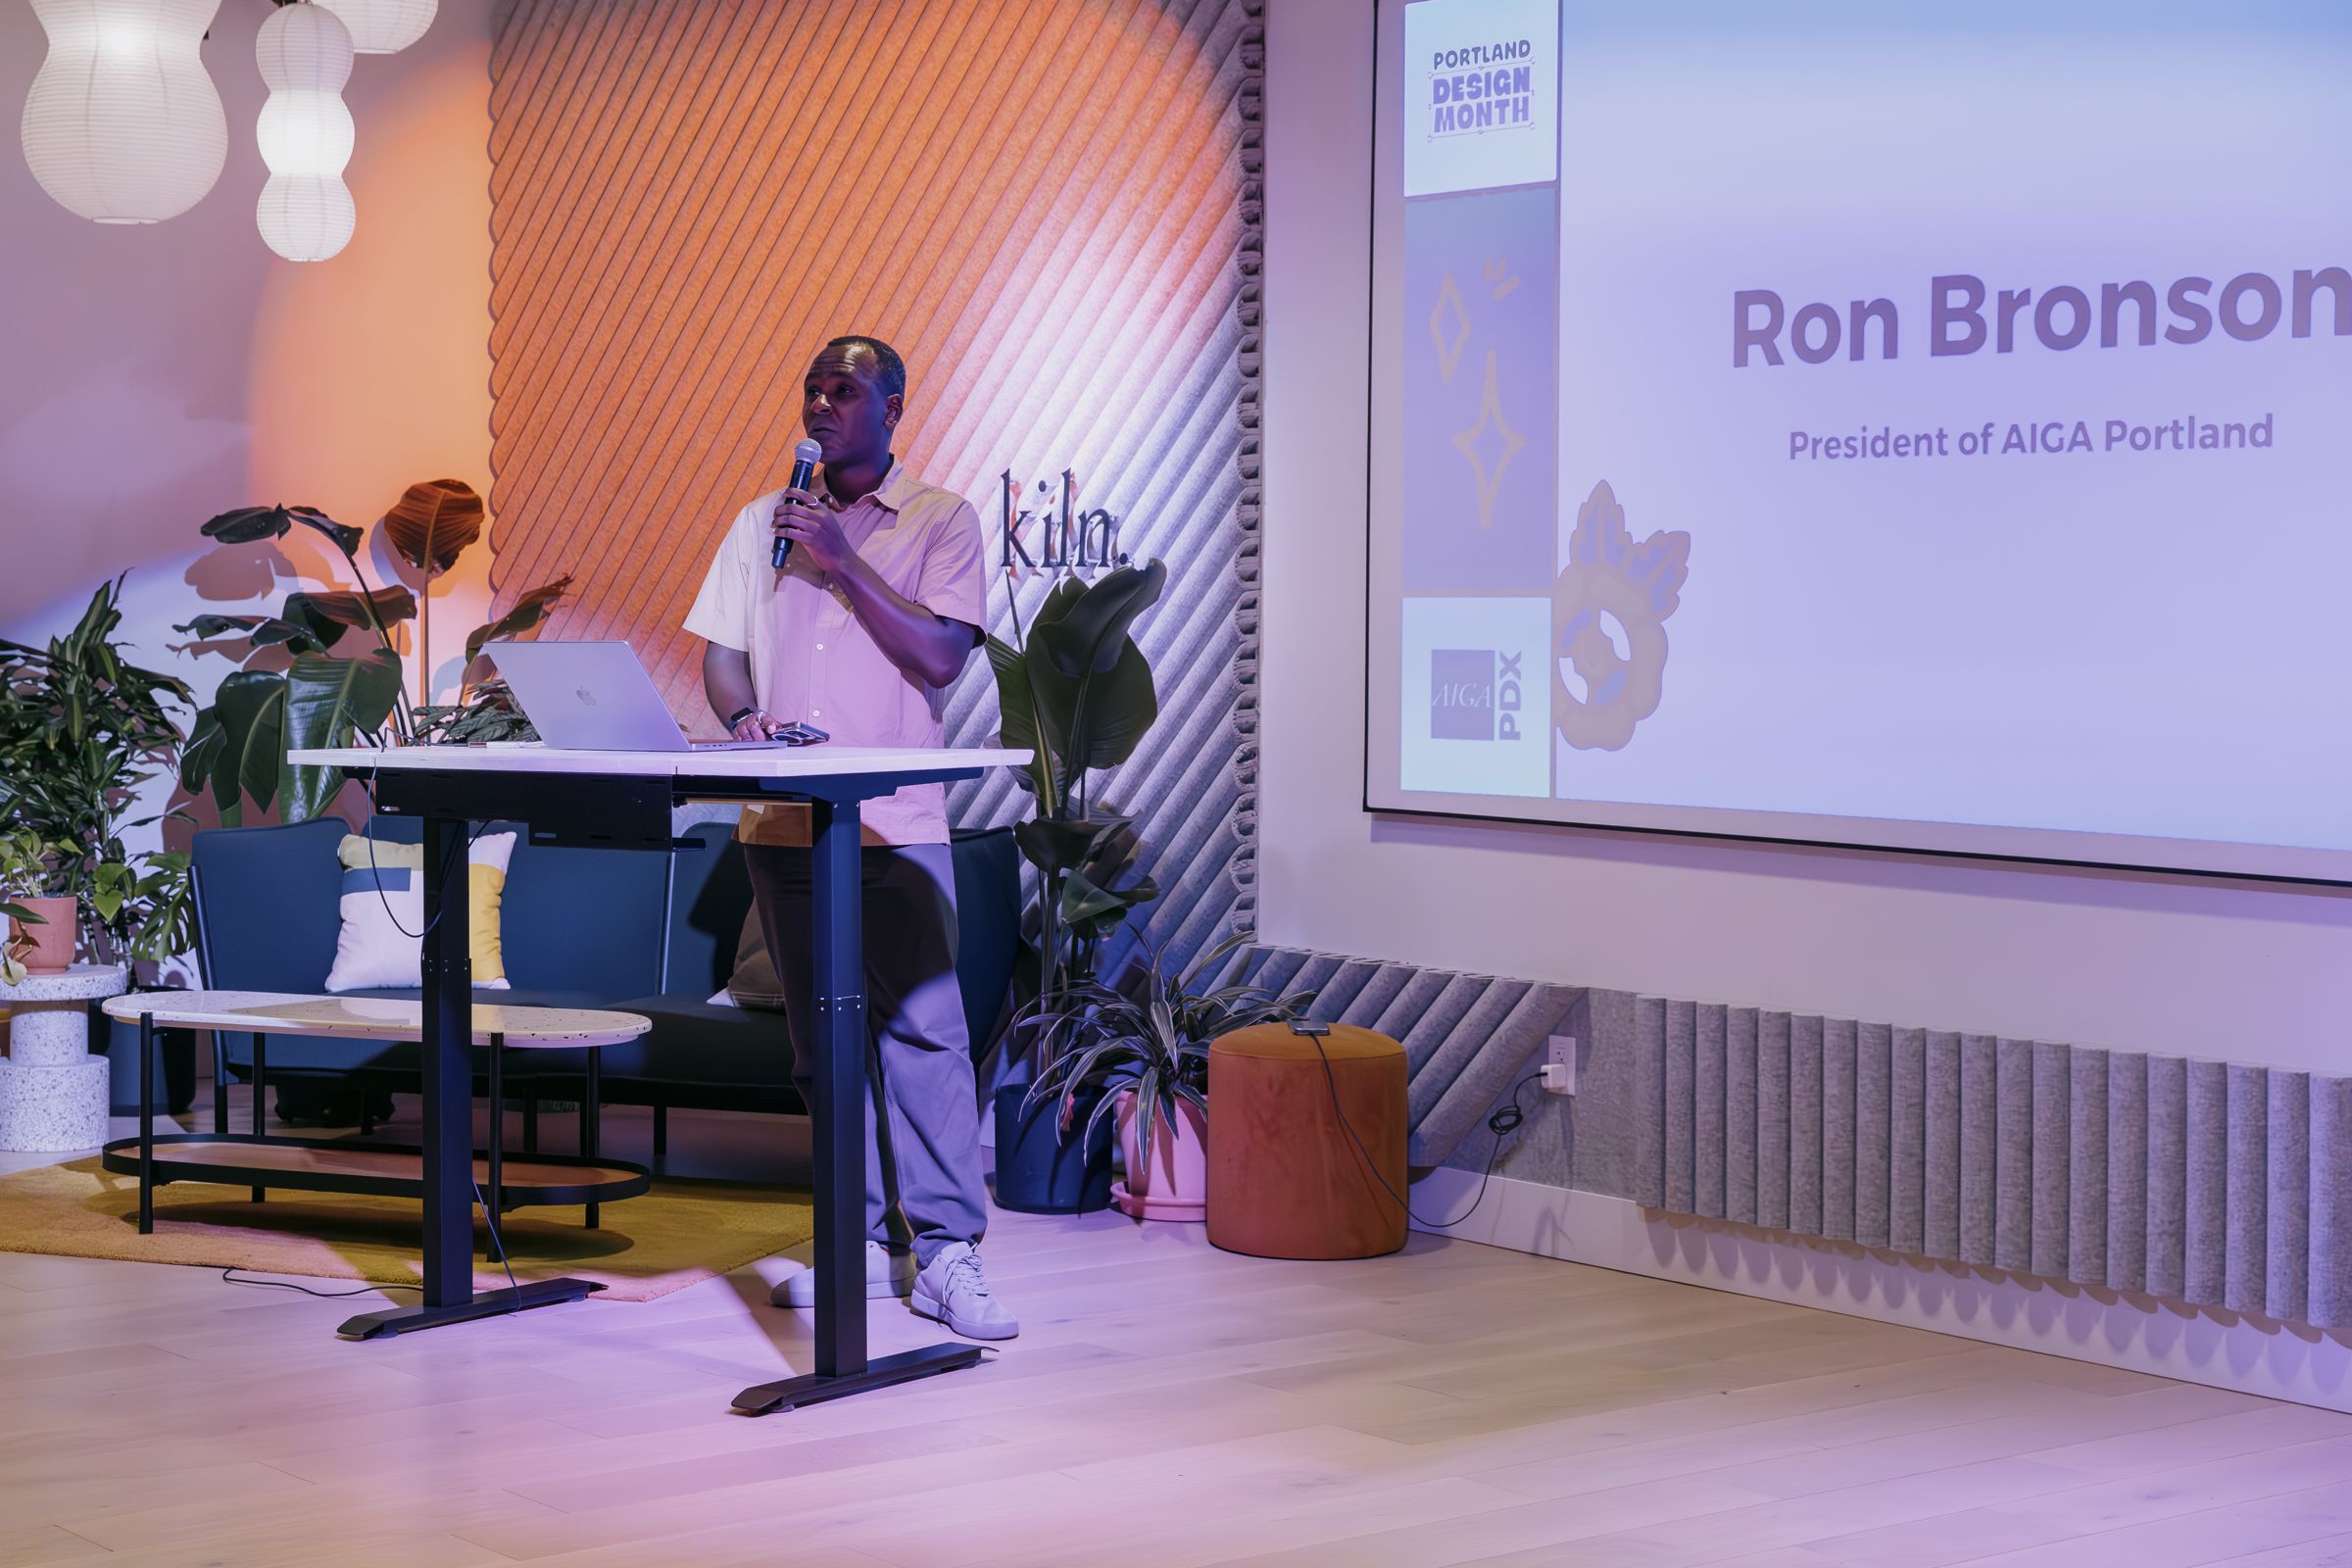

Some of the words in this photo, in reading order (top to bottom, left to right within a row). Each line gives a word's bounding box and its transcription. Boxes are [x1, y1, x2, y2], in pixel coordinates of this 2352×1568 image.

[1434, 39, 1531, 70] PORTLAND
[1433, 66, 1531, 105] DESIGN
[1434, 95, 1529, 132] MONTH
[1734, 289, 1898, 368] Ron
[1931, 267, 2352, 357] Bronson
[1789, 425, 1948, 460] President
[1959, 422, 1994, 455] of
[2001, 421, 2093, 454] AIGA
[2105, 413, 2273, 452] Portland
[1001, 467, 1129, 567] kiln.
[1432, 682, 1492, 708] AIGA
[1498, 650, 1521, 741] PDX
